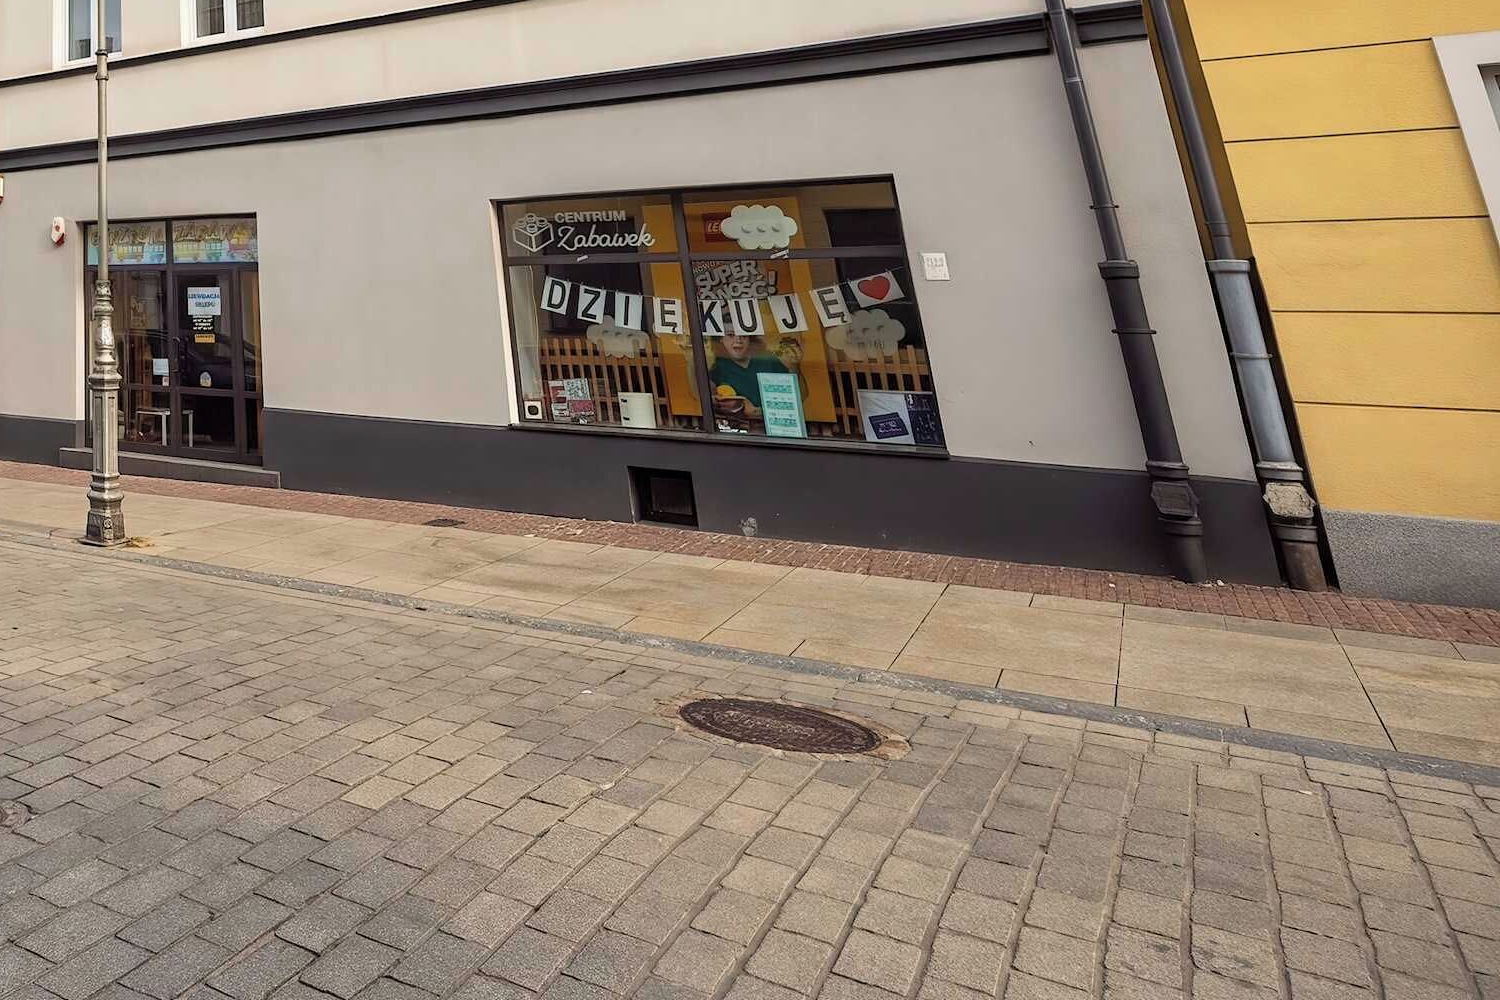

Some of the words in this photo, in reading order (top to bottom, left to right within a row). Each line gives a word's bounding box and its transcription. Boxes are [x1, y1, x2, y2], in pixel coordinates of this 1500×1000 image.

[554, 209, 626, 223] CENTRUM
[707, 222, 720, 232] LE
[557, 223, 656, 251] Zabawek
[695, 260, 760, 287] SUPER
[547, 279, 847, 333] DZIĘKUJĘ
